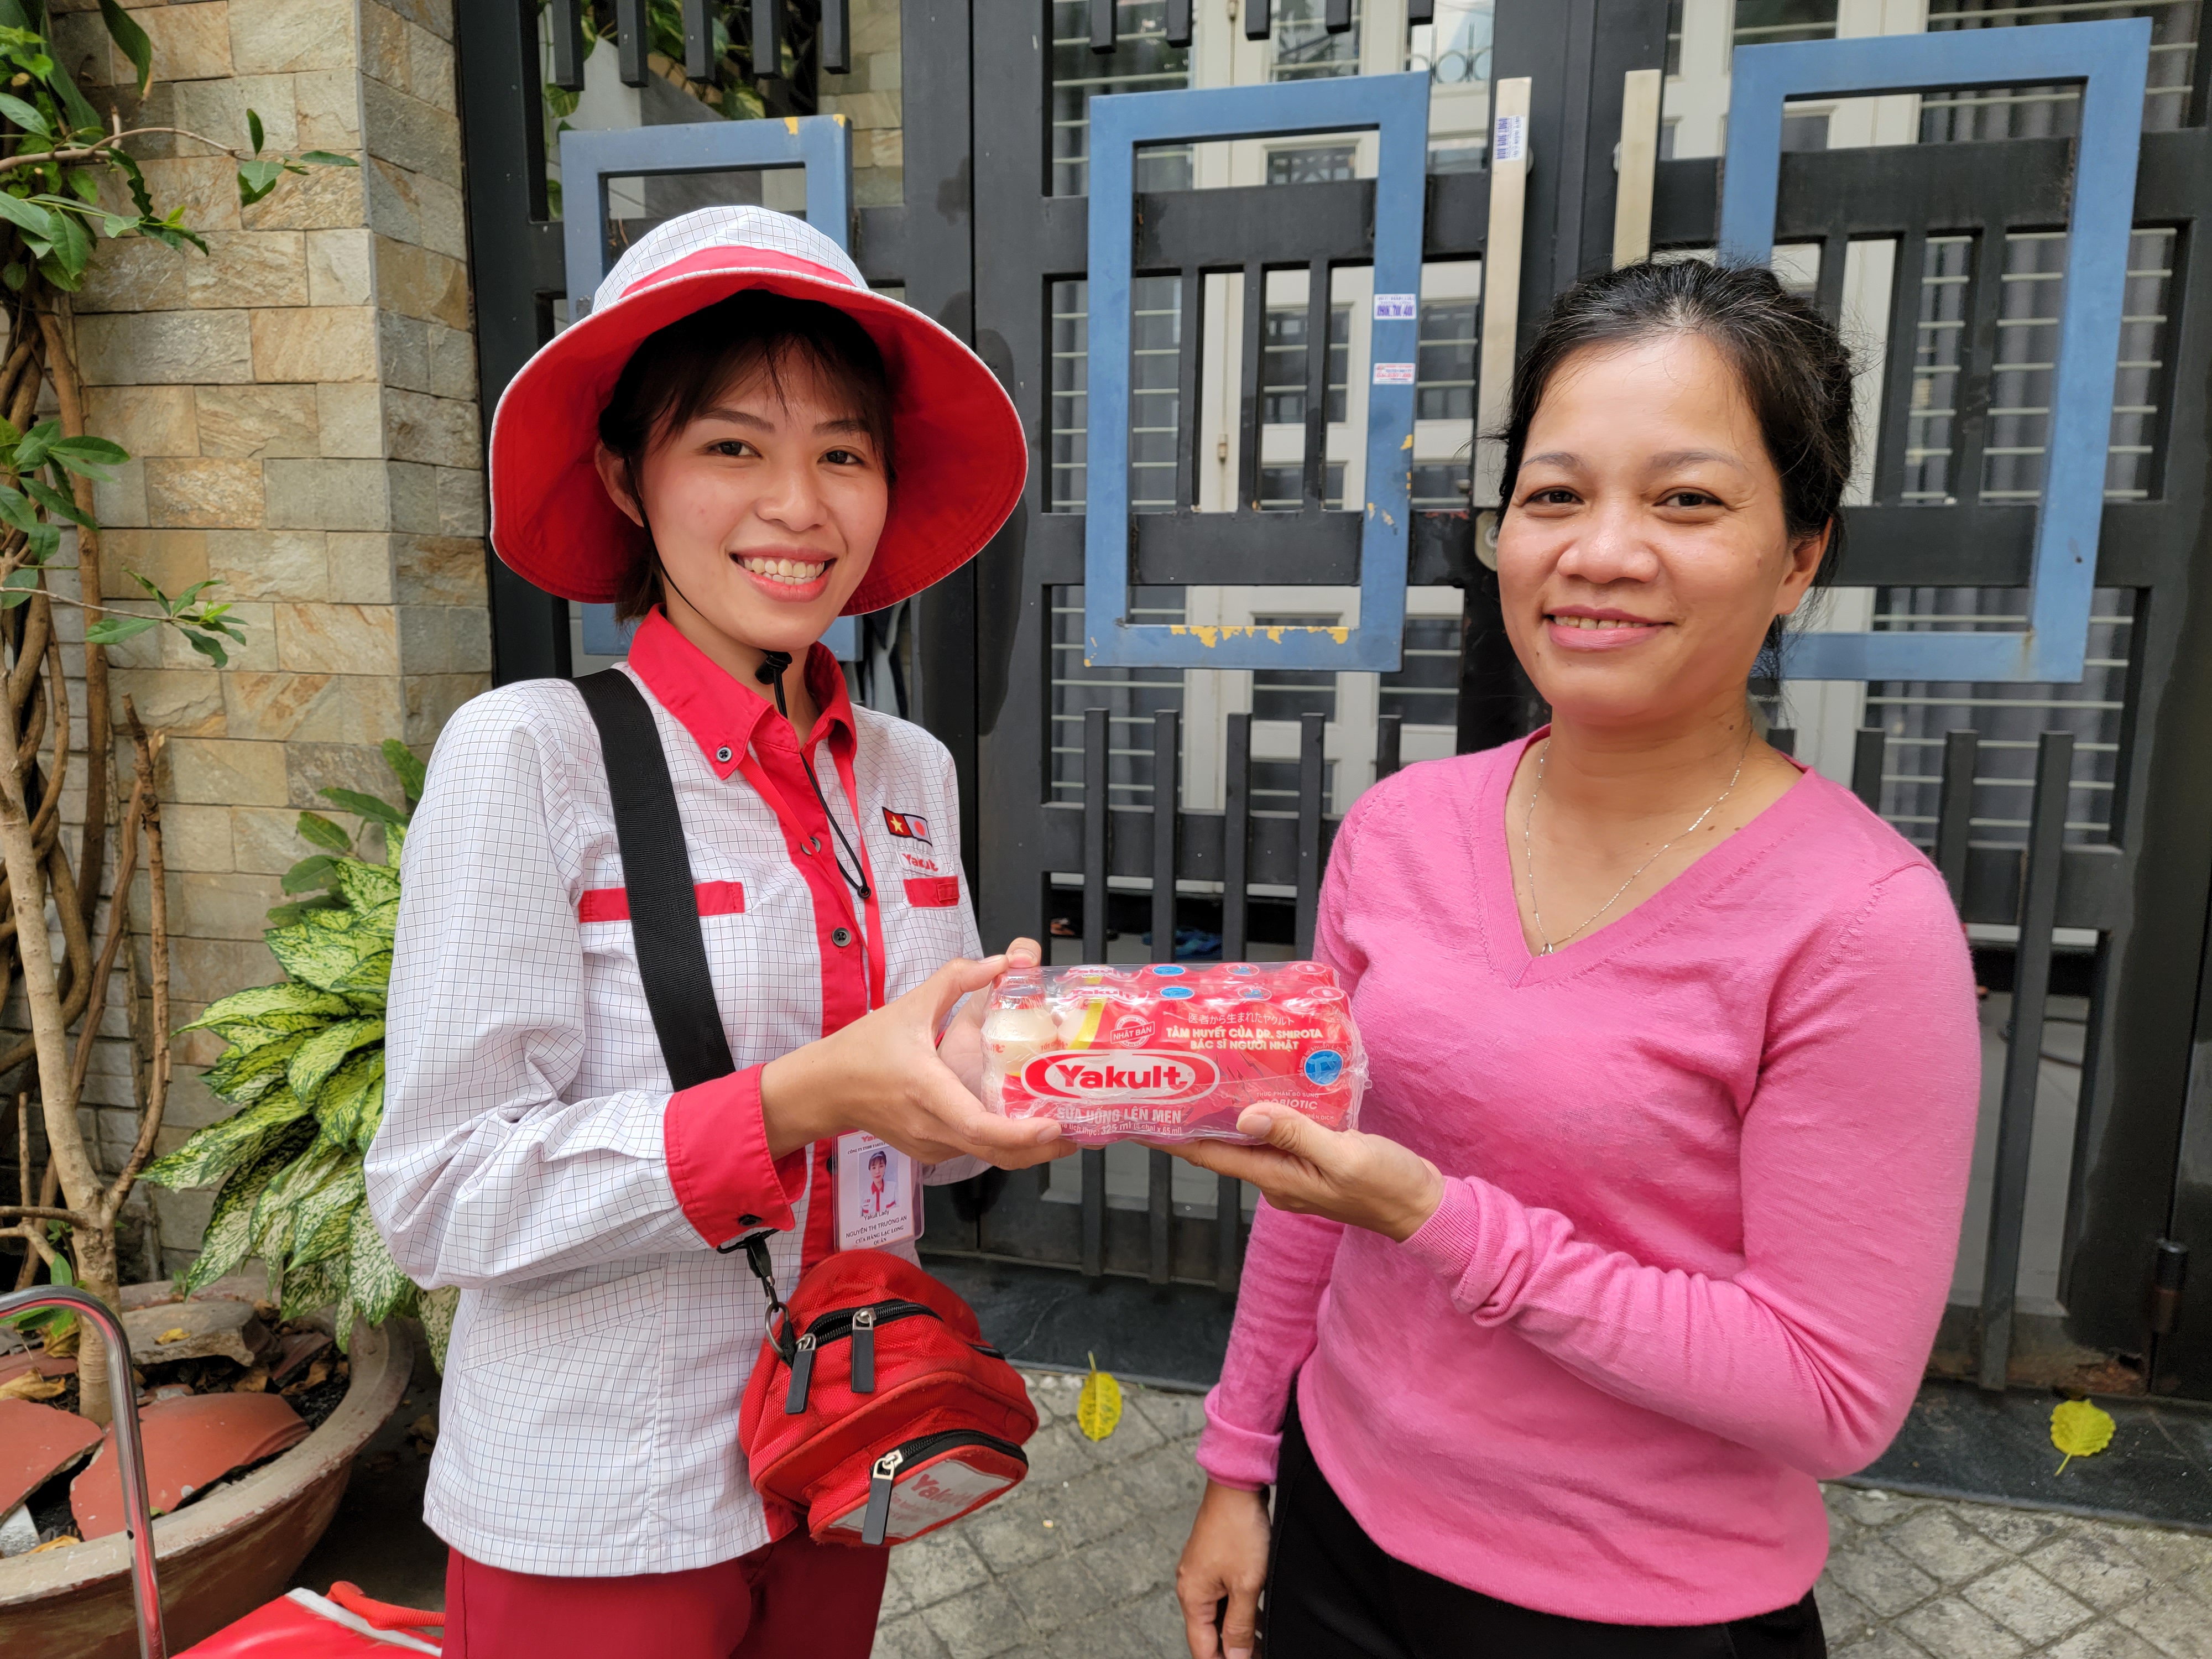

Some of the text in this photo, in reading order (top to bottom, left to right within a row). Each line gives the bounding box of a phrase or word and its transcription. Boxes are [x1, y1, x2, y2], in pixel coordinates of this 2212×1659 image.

[1190, 1011, 1295, 1026] 医者から生まれたヤクルト
[1113, 1029, 1134, 1041] NHẬT
[1135, 1025, 1152, 1036] BẢN
[1166, 1024, 1323, 1039] TÂM HUYẾT CỦA DR. SHIROTA
[1190, 1039, 1299, 1052] BÁC SĨ NGƯỜI NHẬT
[1055, 1065, 1189, 1091] Yakult
[1124, 1106, 1149, 1121] LÊN
[1152, 1108, 1182, 1124] MEN
[1101, 1123, 1118, 1135] 325
[1119, 1121, 1131, 1130] ml
[1162, 1126, 1171, 1135] 65
[891, 1225, 904, 1234] LONG
